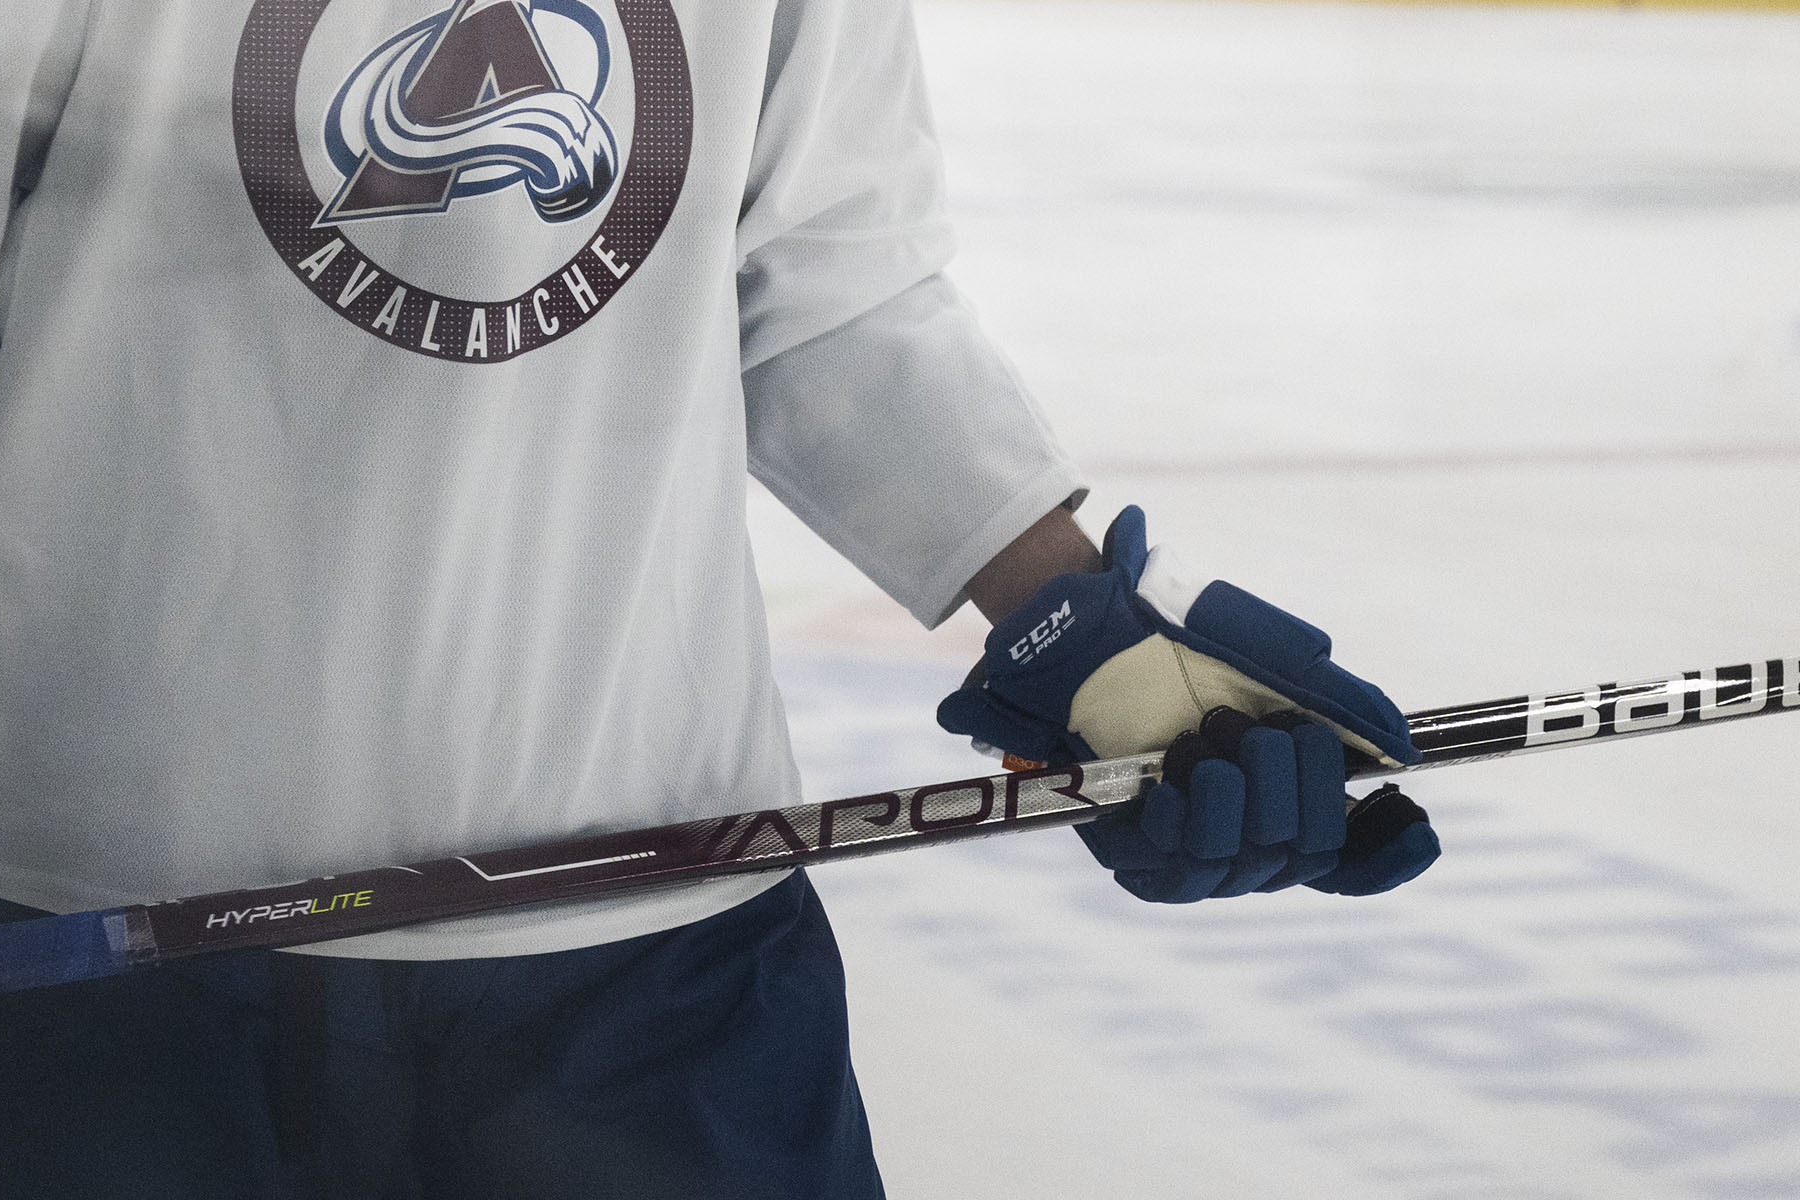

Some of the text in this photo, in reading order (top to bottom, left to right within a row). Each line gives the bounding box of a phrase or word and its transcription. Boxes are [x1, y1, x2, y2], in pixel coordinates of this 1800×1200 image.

[297, 234, 630, 358] AVALANCHE
[1009, 600, 1071, 660] CCM
[1035, 629, 1062, 654] PRO
[206, 890, 375, 928] HYPERLITE
